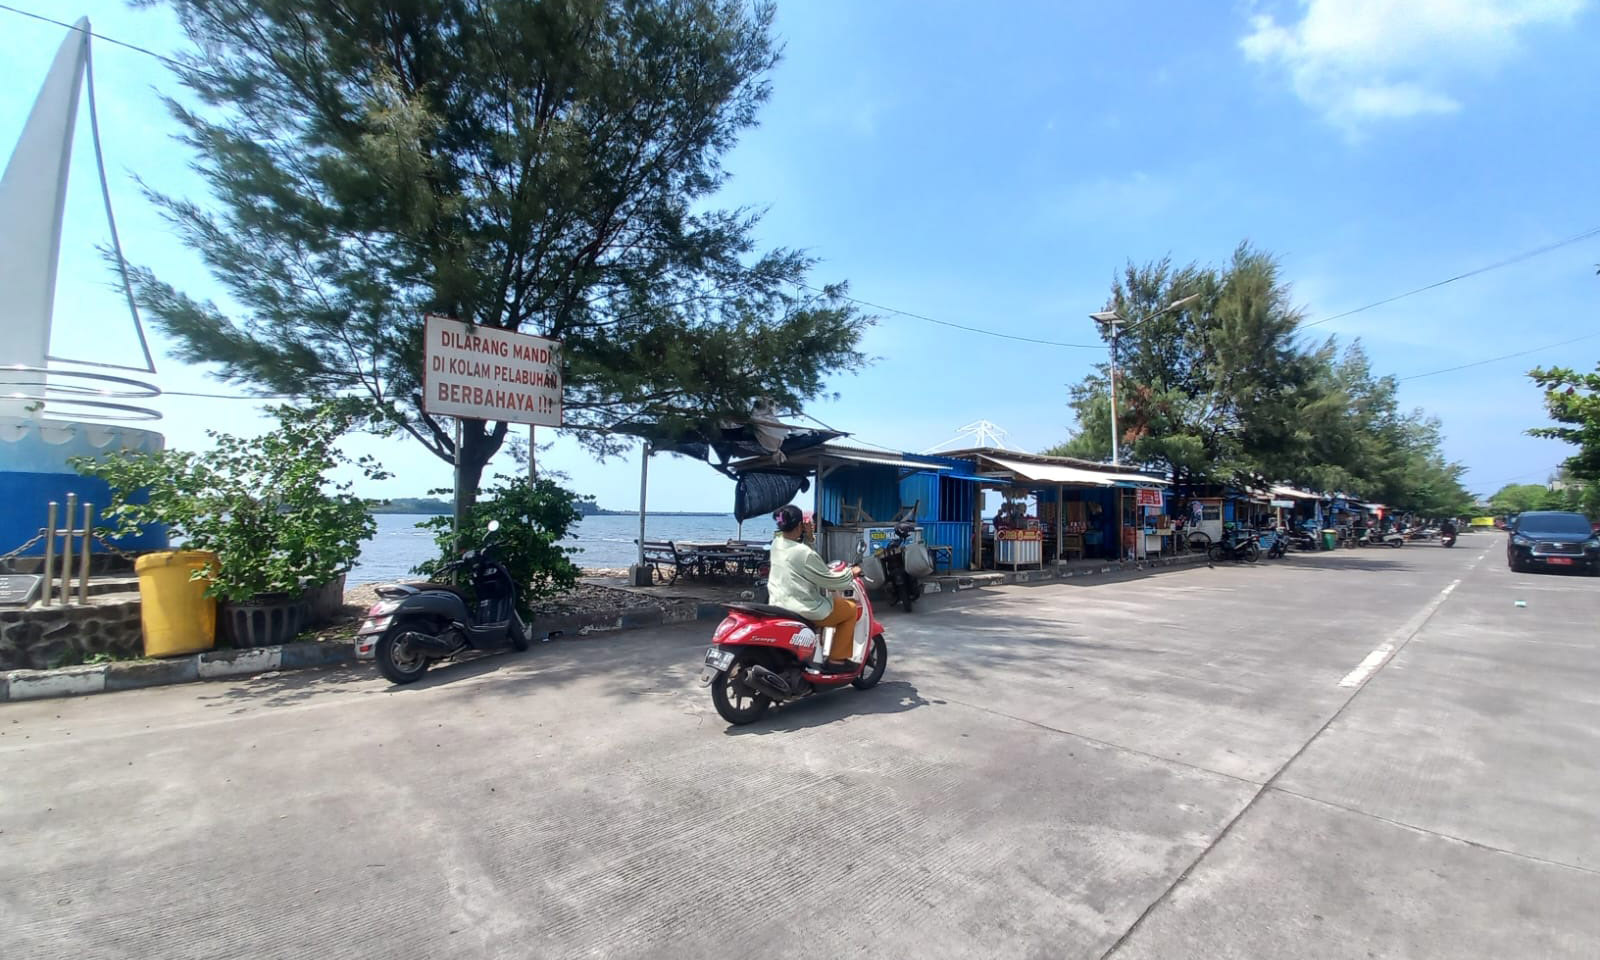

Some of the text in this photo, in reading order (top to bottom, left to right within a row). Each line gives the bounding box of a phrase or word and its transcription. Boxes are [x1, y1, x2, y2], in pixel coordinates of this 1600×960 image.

[441, 330, 508, 357] DILARANG
[432, 355, 557, 389] DI KOLAM PELABUHAN
[438, 382, 534, 412] BERBAHAYA
